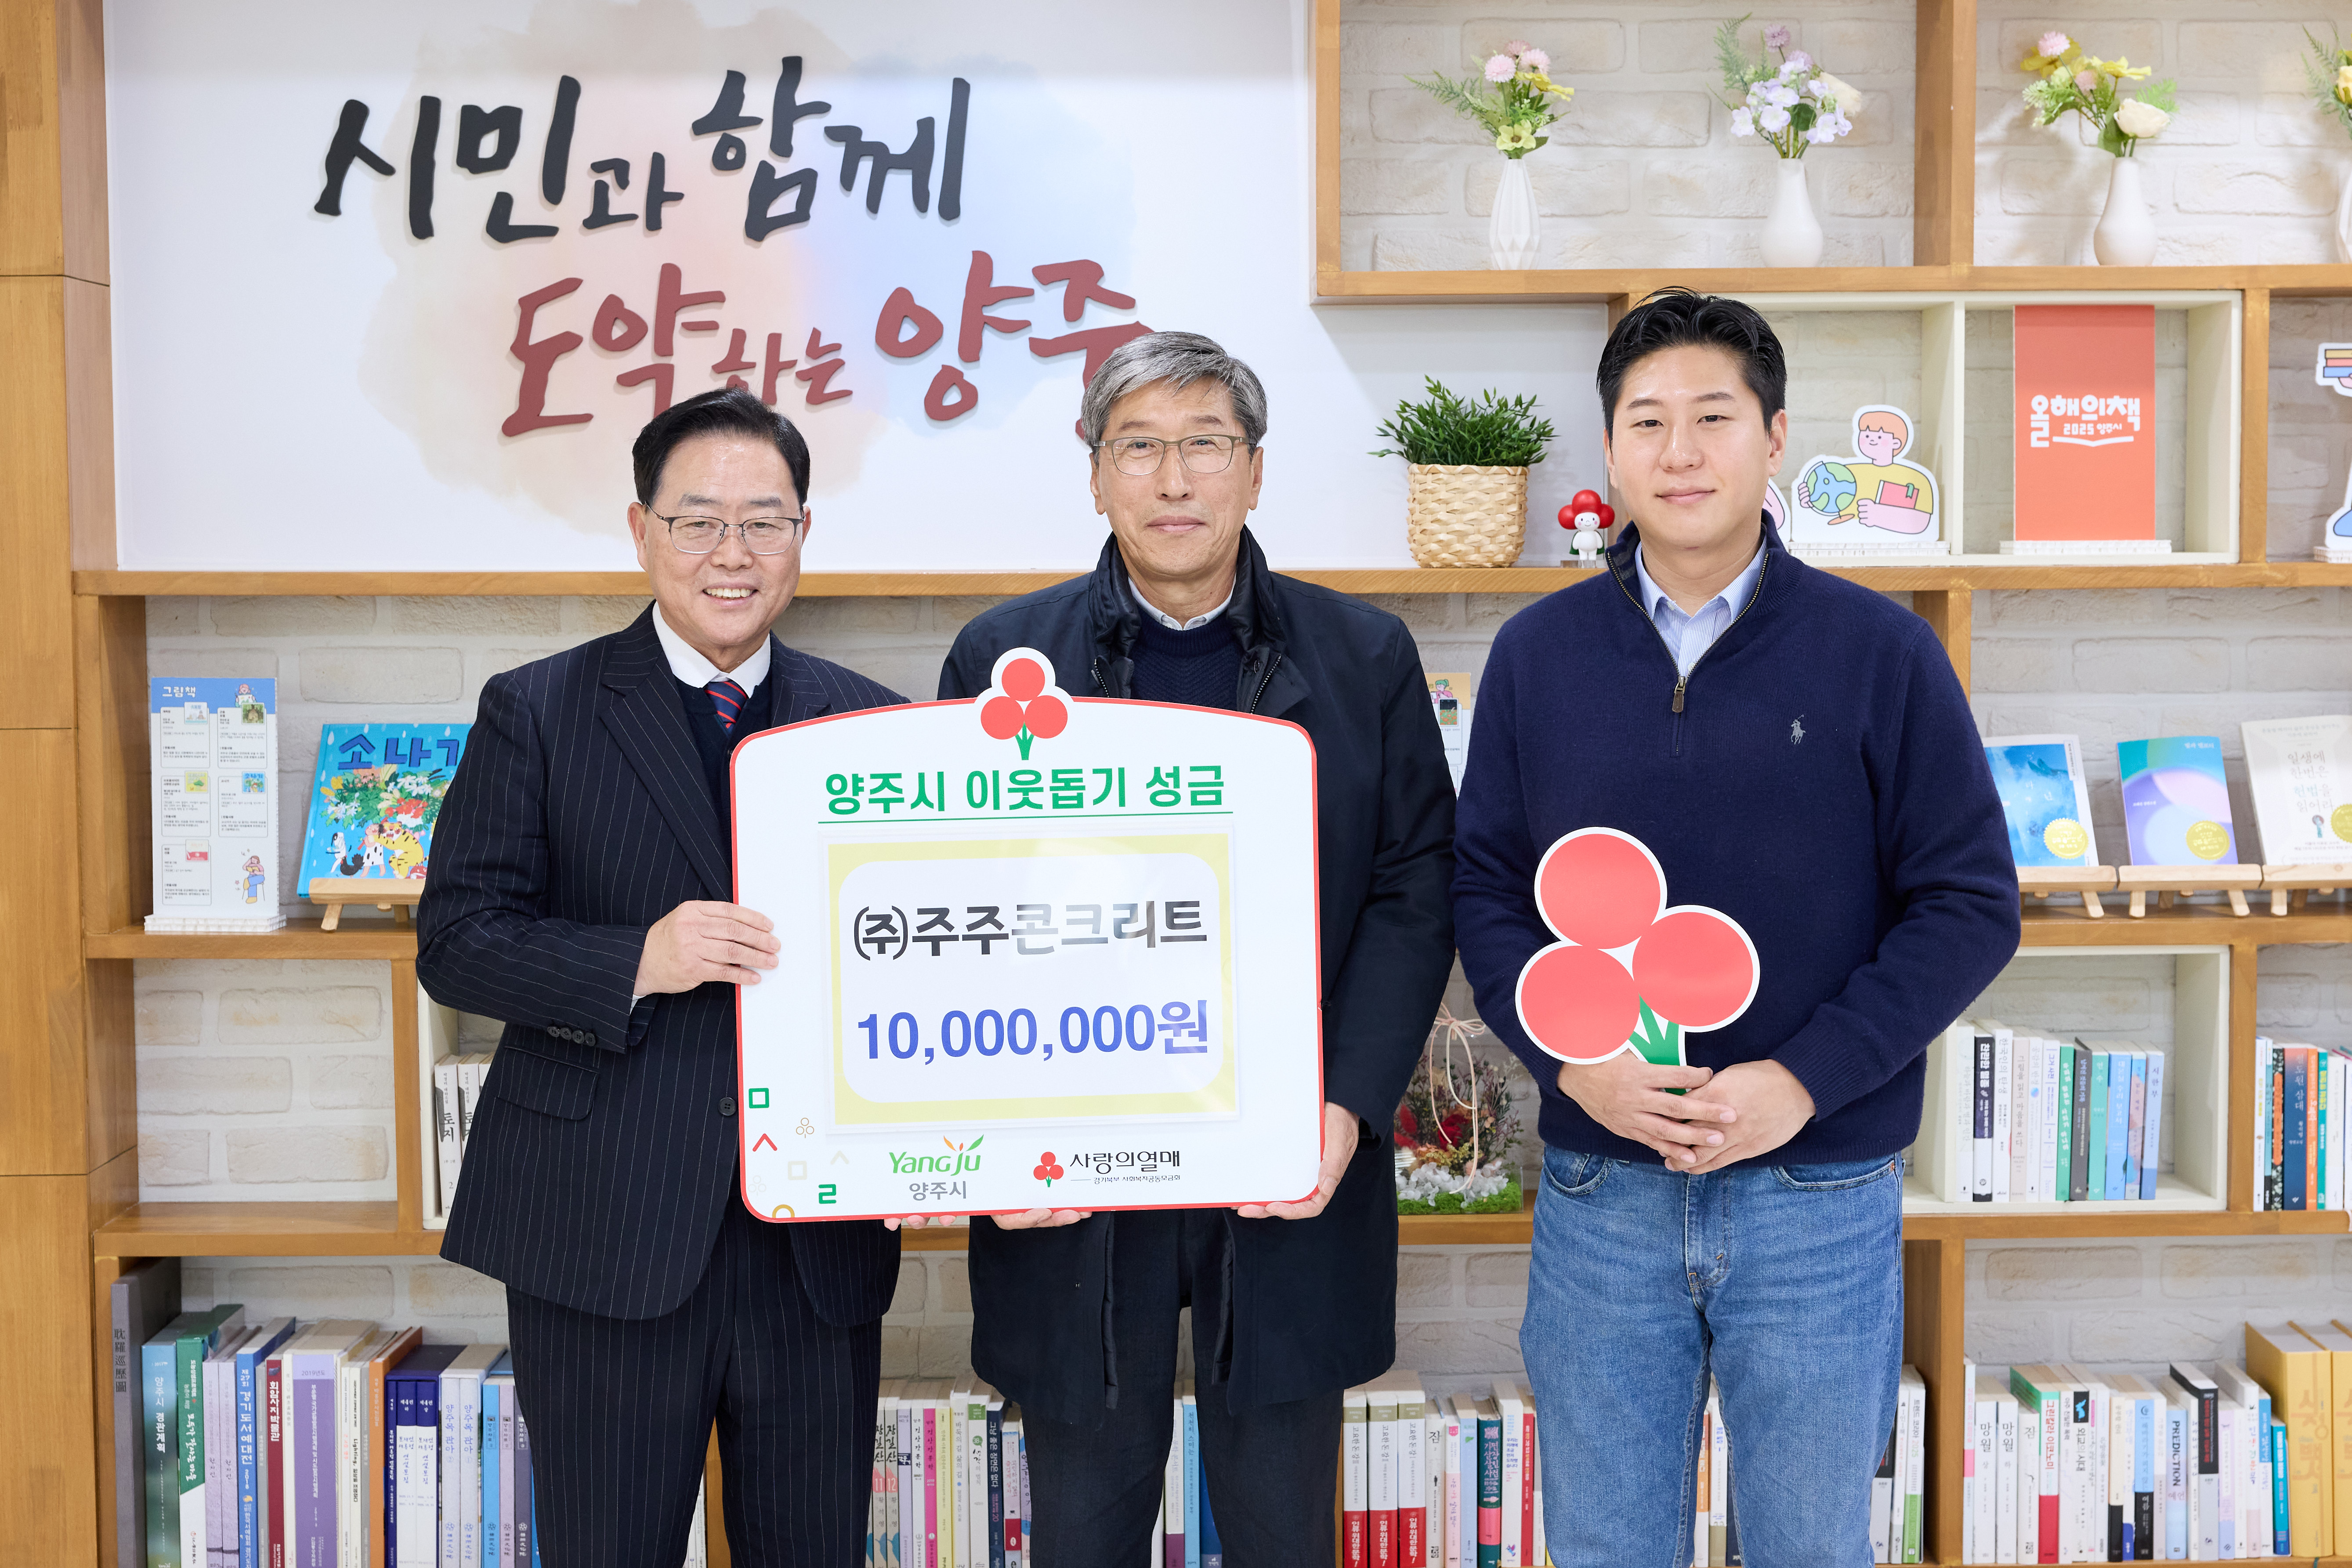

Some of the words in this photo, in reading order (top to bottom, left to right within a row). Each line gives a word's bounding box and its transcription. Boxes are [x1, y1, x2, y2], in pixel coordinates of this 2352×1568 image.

[314, 74, 684, 243] 시민과
[691, 55, 971, 242] 함께
[2063, 423, 2094, 436] 2025
[2096, 422, 2123, 435] 양주시
[162, 686, 196, 698] 그림책
[2288, 750, 2325, 764] 일생에
[825, 771, 945, 815] 양주시
[966, 767, 1127, 811] 이웃돕기
[1145, 765, 1226, 807] 성금
[858, 999, 1209, 1065] 10,000,000원
[1980, 1043, 1990, 1069] 찬란한
[1999, 1038, 2008, 1073] 한국인의
[1998, 1077, 2008, 1094] 탄생
[444, 1113, 455, 1142] 토지
[1070, 1151, 1180, 1174] 사랑의열매
[909, 1181, 966, 1201] 양주시
[1093, 1177, 1119, 1185] 경기북부
[1122, 1174, 1180, 1183] 사회복지공동모금회
[155, 1377, 164, 1407] 양주시
[186, 1413, 196, 1436] 모두가
[240, 1391, 252, 1465] 경기도서예대전
[445, 1405, 455, 1432] 양주목
[464, 1405, 474, 1432] 양주목
[989, 1421, 997, 1435] 그냥
[156, 1412, 165, 1453] 경관계획
[886, 1424, 897, 1463] 장길산
[990, 1437, 997, 1450] 좋은
[1980, 1422, 1992, 1452] 망월
[2002, 1422, 2014, 1452] 망월
[445, 1436, 455, 1453] 관아
[464, 1436, 474, 1454] 관아
[2045, 1437, 2055, 1469] 이코노미
[2172, 1420, 2181, 1486] PREDICTION
[186, 1463, 197, 1481] 마을
[2076, 1455, 2085, 1471] 시대
[875, 1478, 883, 1491] 11
[887, 1478, 896, 1491] 12
[991, 1474, 999, 1488] 없다
